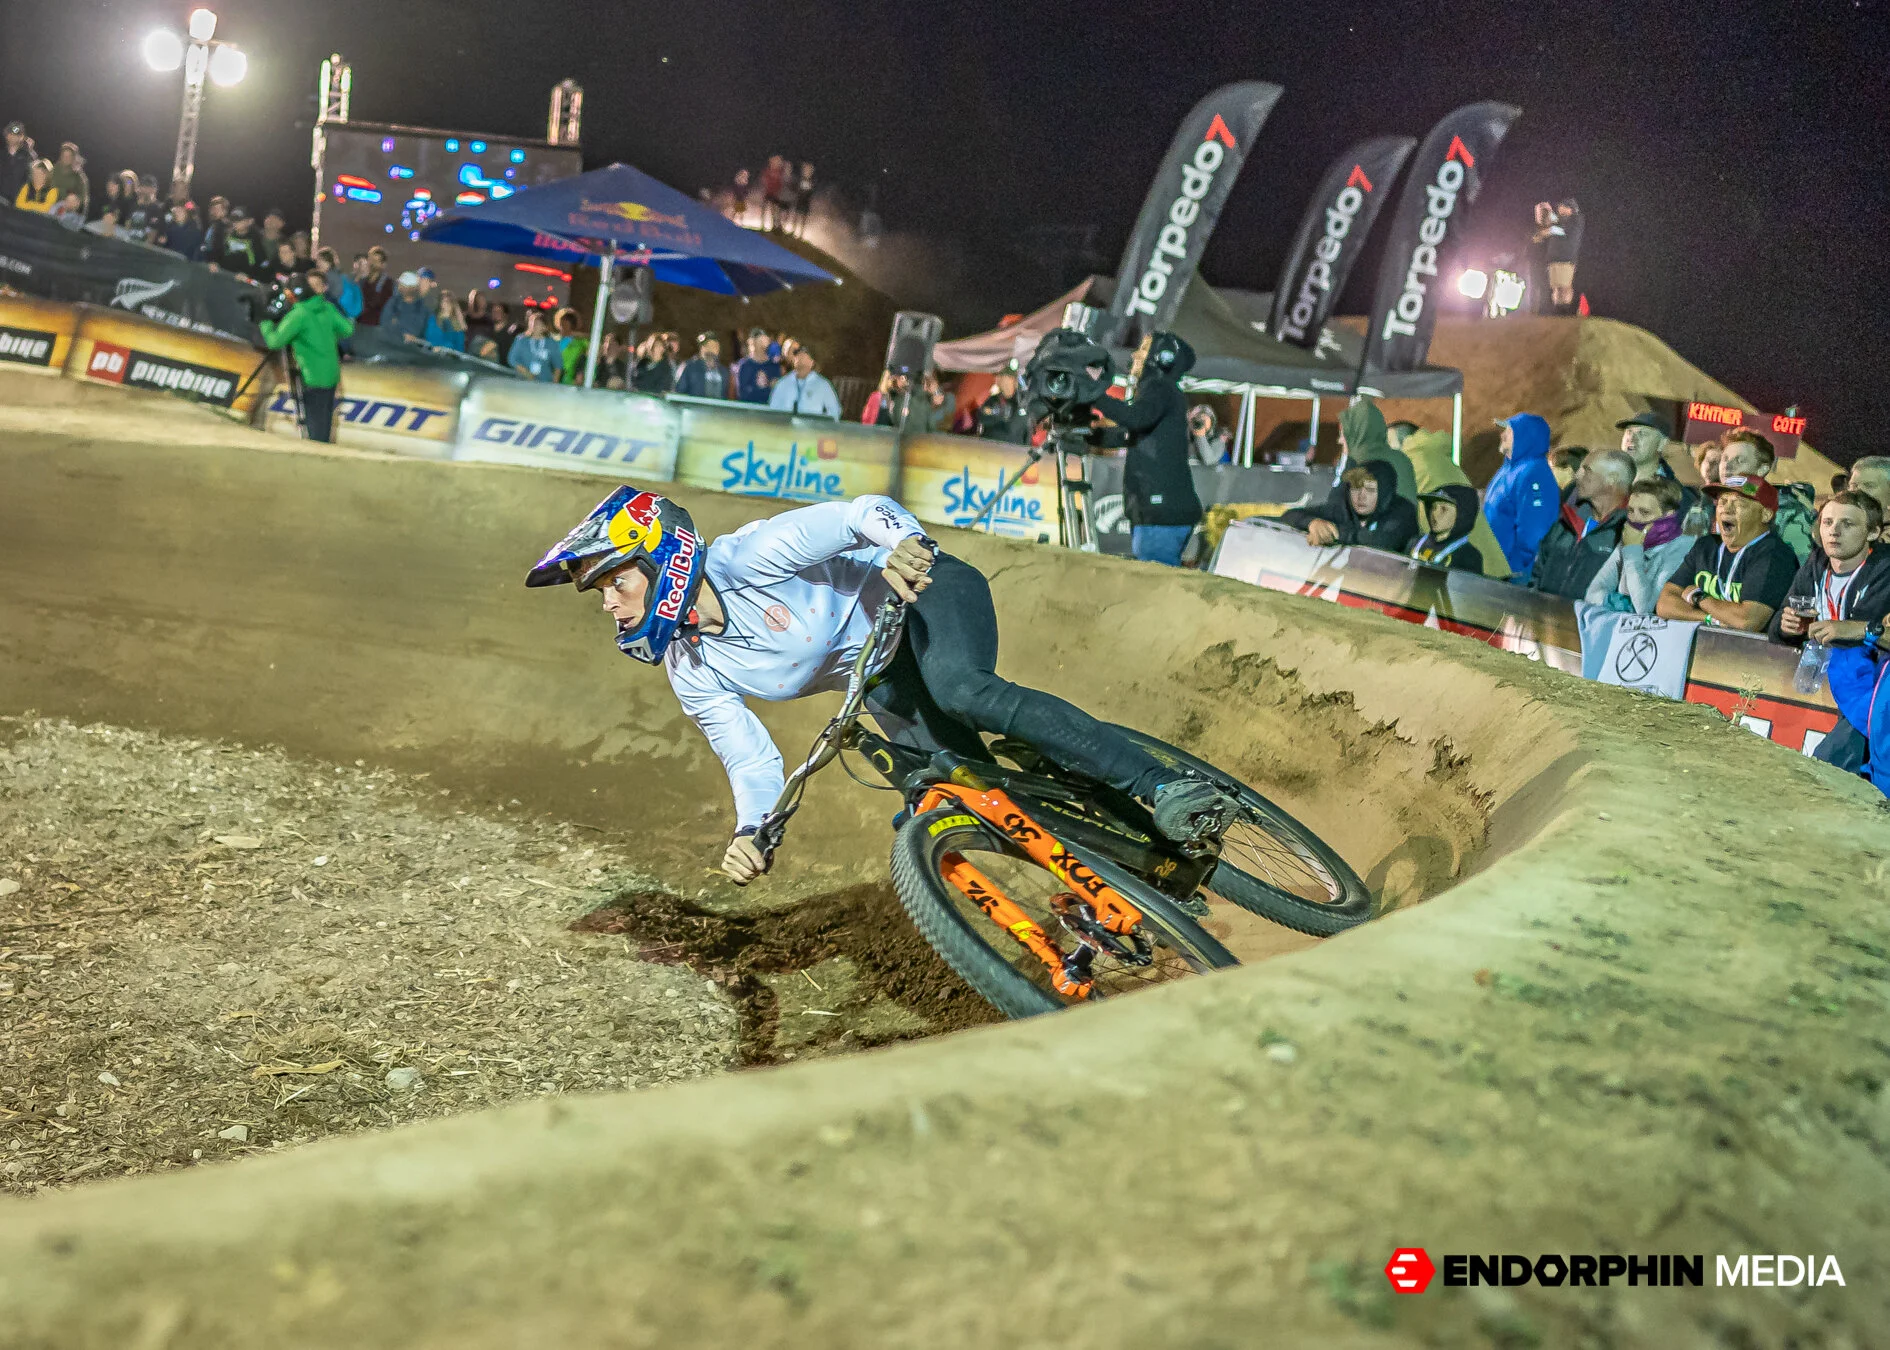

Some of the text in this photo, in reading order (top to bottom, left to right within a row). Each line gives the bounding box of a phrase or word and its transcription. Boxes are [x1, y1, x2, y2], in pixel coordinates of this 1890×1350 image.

[1125, 114, 1236, 316] Torpedo7
[1381, 136, 1475, 340] Torpedo7
[472, 417, 662, 462] GIANT
[875, 506, 903, 529] NRCO
[656, 526, 697, 621] Red Bull
[1050, 850, 1106, 898] FOX
